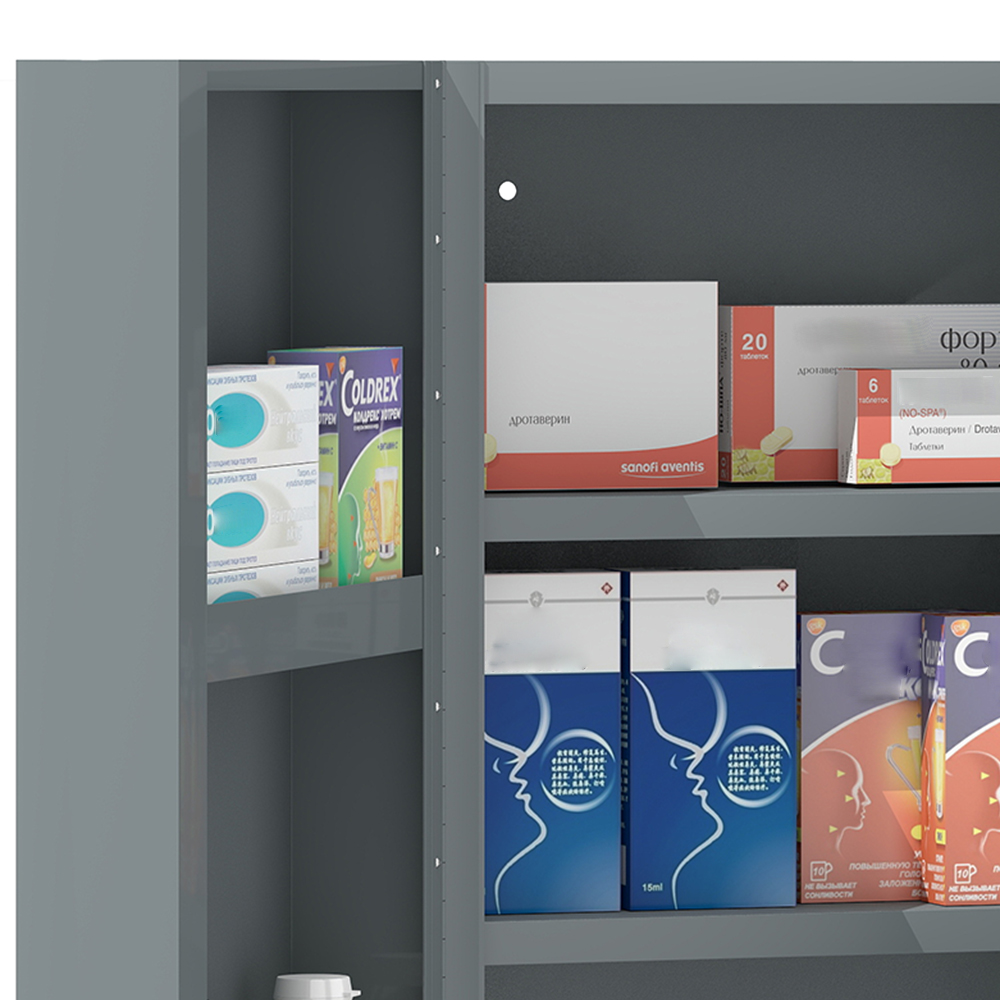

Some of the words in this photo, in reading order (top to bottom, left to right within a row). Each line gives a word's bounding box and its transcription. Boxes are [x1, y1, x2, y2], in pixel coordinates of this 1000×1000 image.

[742, 333, 768, 351] 20
[797, 367, 840, 376] дротавер
[868, 378, 879, 393] 6
[341, 369, 400, 417] COLDREX
[508, 414, 571, 428] дротаверин
[621, 461, 658, 473] sanofi
[661, 461, 705, 473] aventis
[813, 867, 825, 876] 10
[957, 869, 969, 878] 10
[642, 882, 663, 892] 15ml
